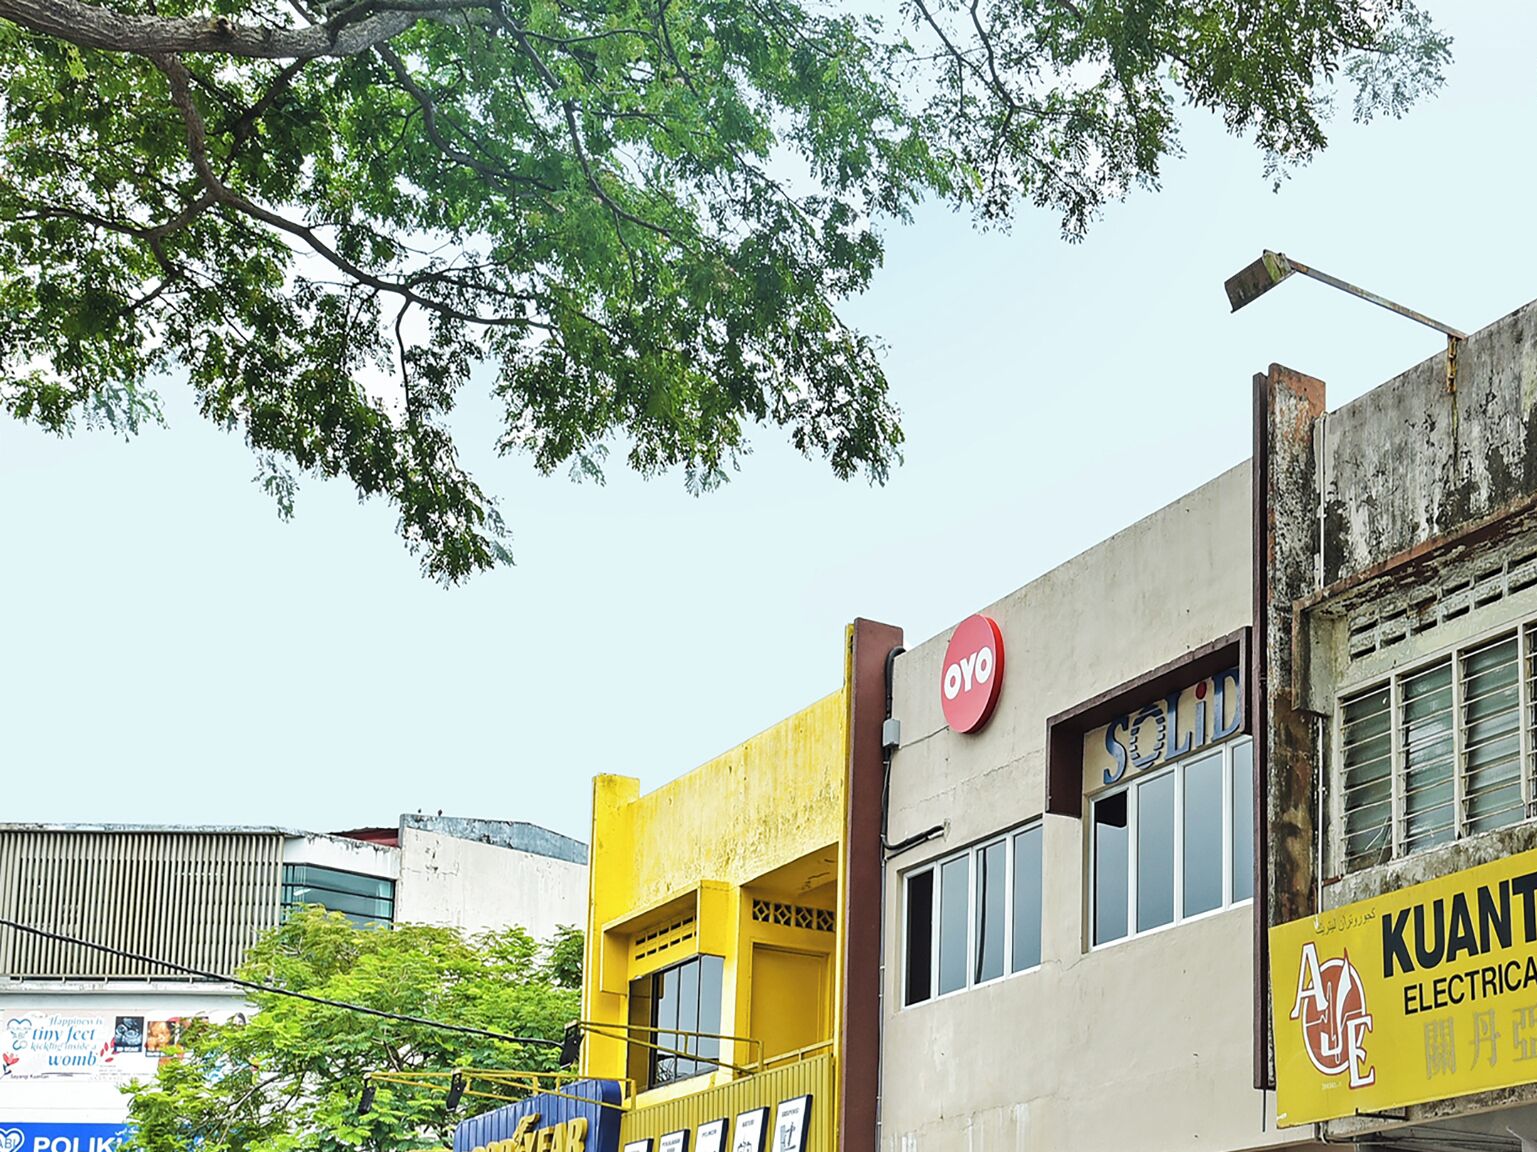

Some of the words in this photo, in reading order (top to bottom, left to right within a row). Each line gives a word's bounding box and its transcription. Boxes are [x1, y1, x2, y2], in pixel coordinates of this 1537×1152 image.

[944, 646, 993, 700] OYO
[32, 1027, 62, 1043] tiny
[66, 1026, 95, 1043] feet
[48, 1050, 97, 1066] womb
